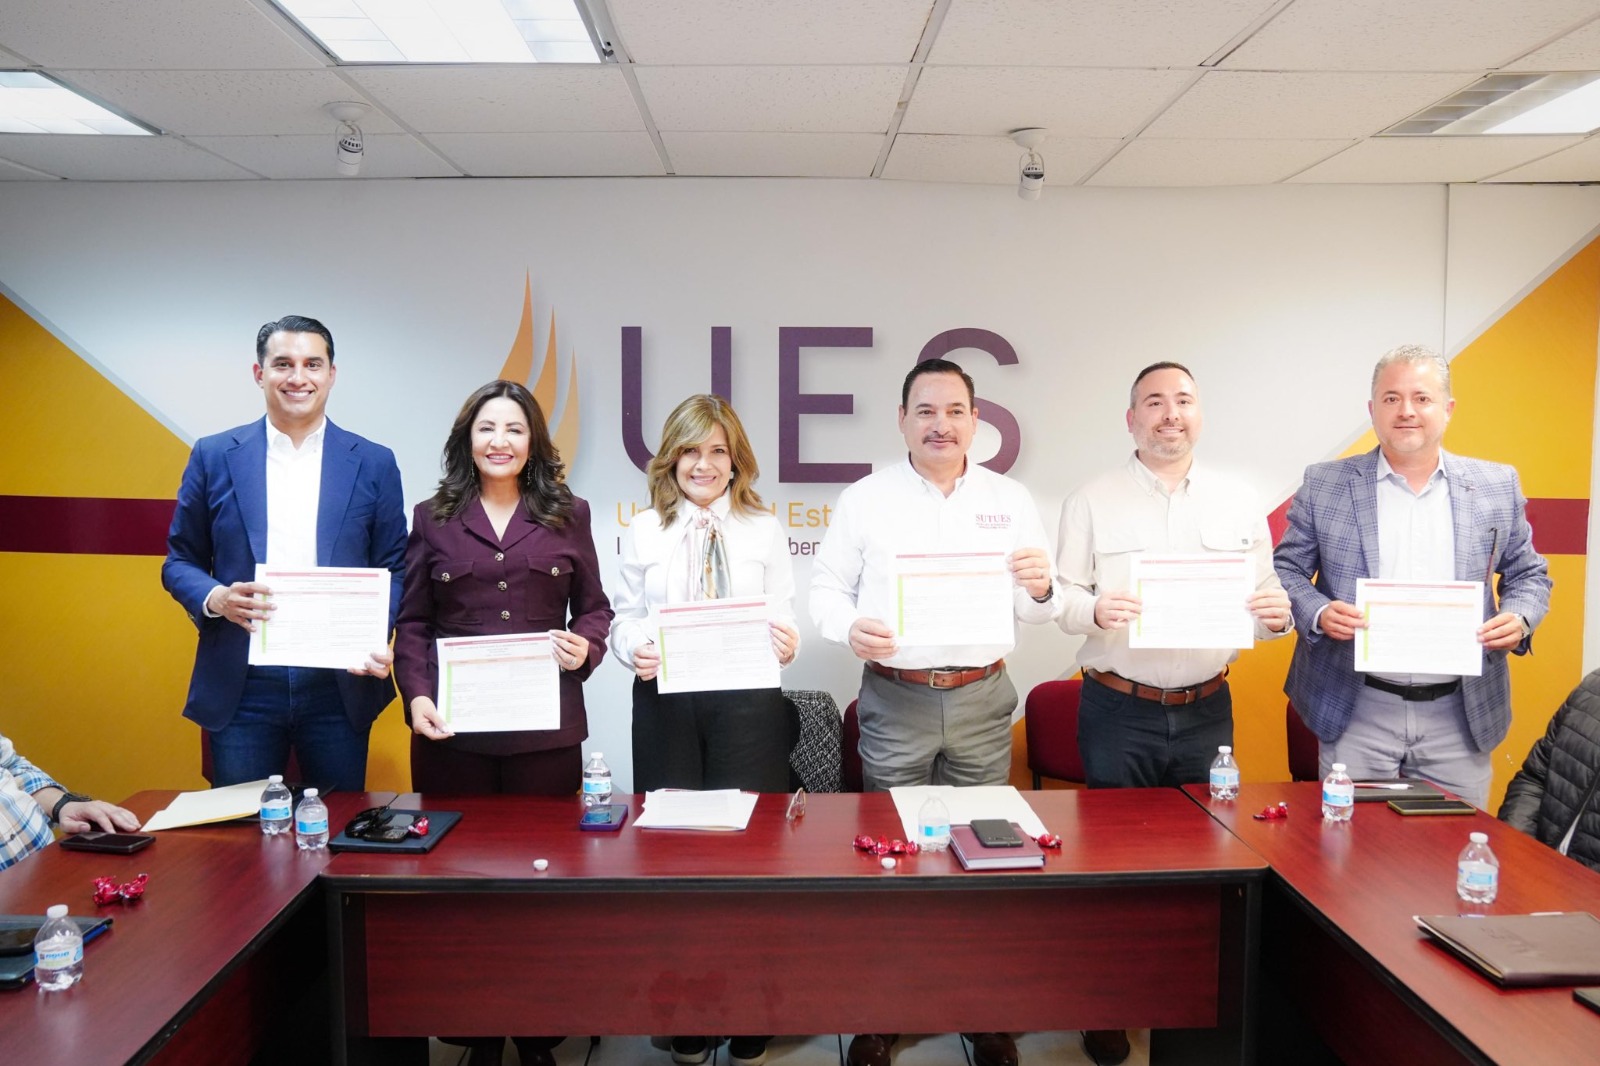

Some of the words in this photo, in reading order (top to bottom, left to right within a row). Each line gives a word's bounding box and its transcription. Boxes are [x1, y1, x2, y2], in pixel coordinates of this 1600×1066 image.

[621, 326, 1020, 483] UES
[788, 502, 832, 528] Est
[975, 513, 1012, 523] SUTUES
[788, 536, 821, 556] ber
